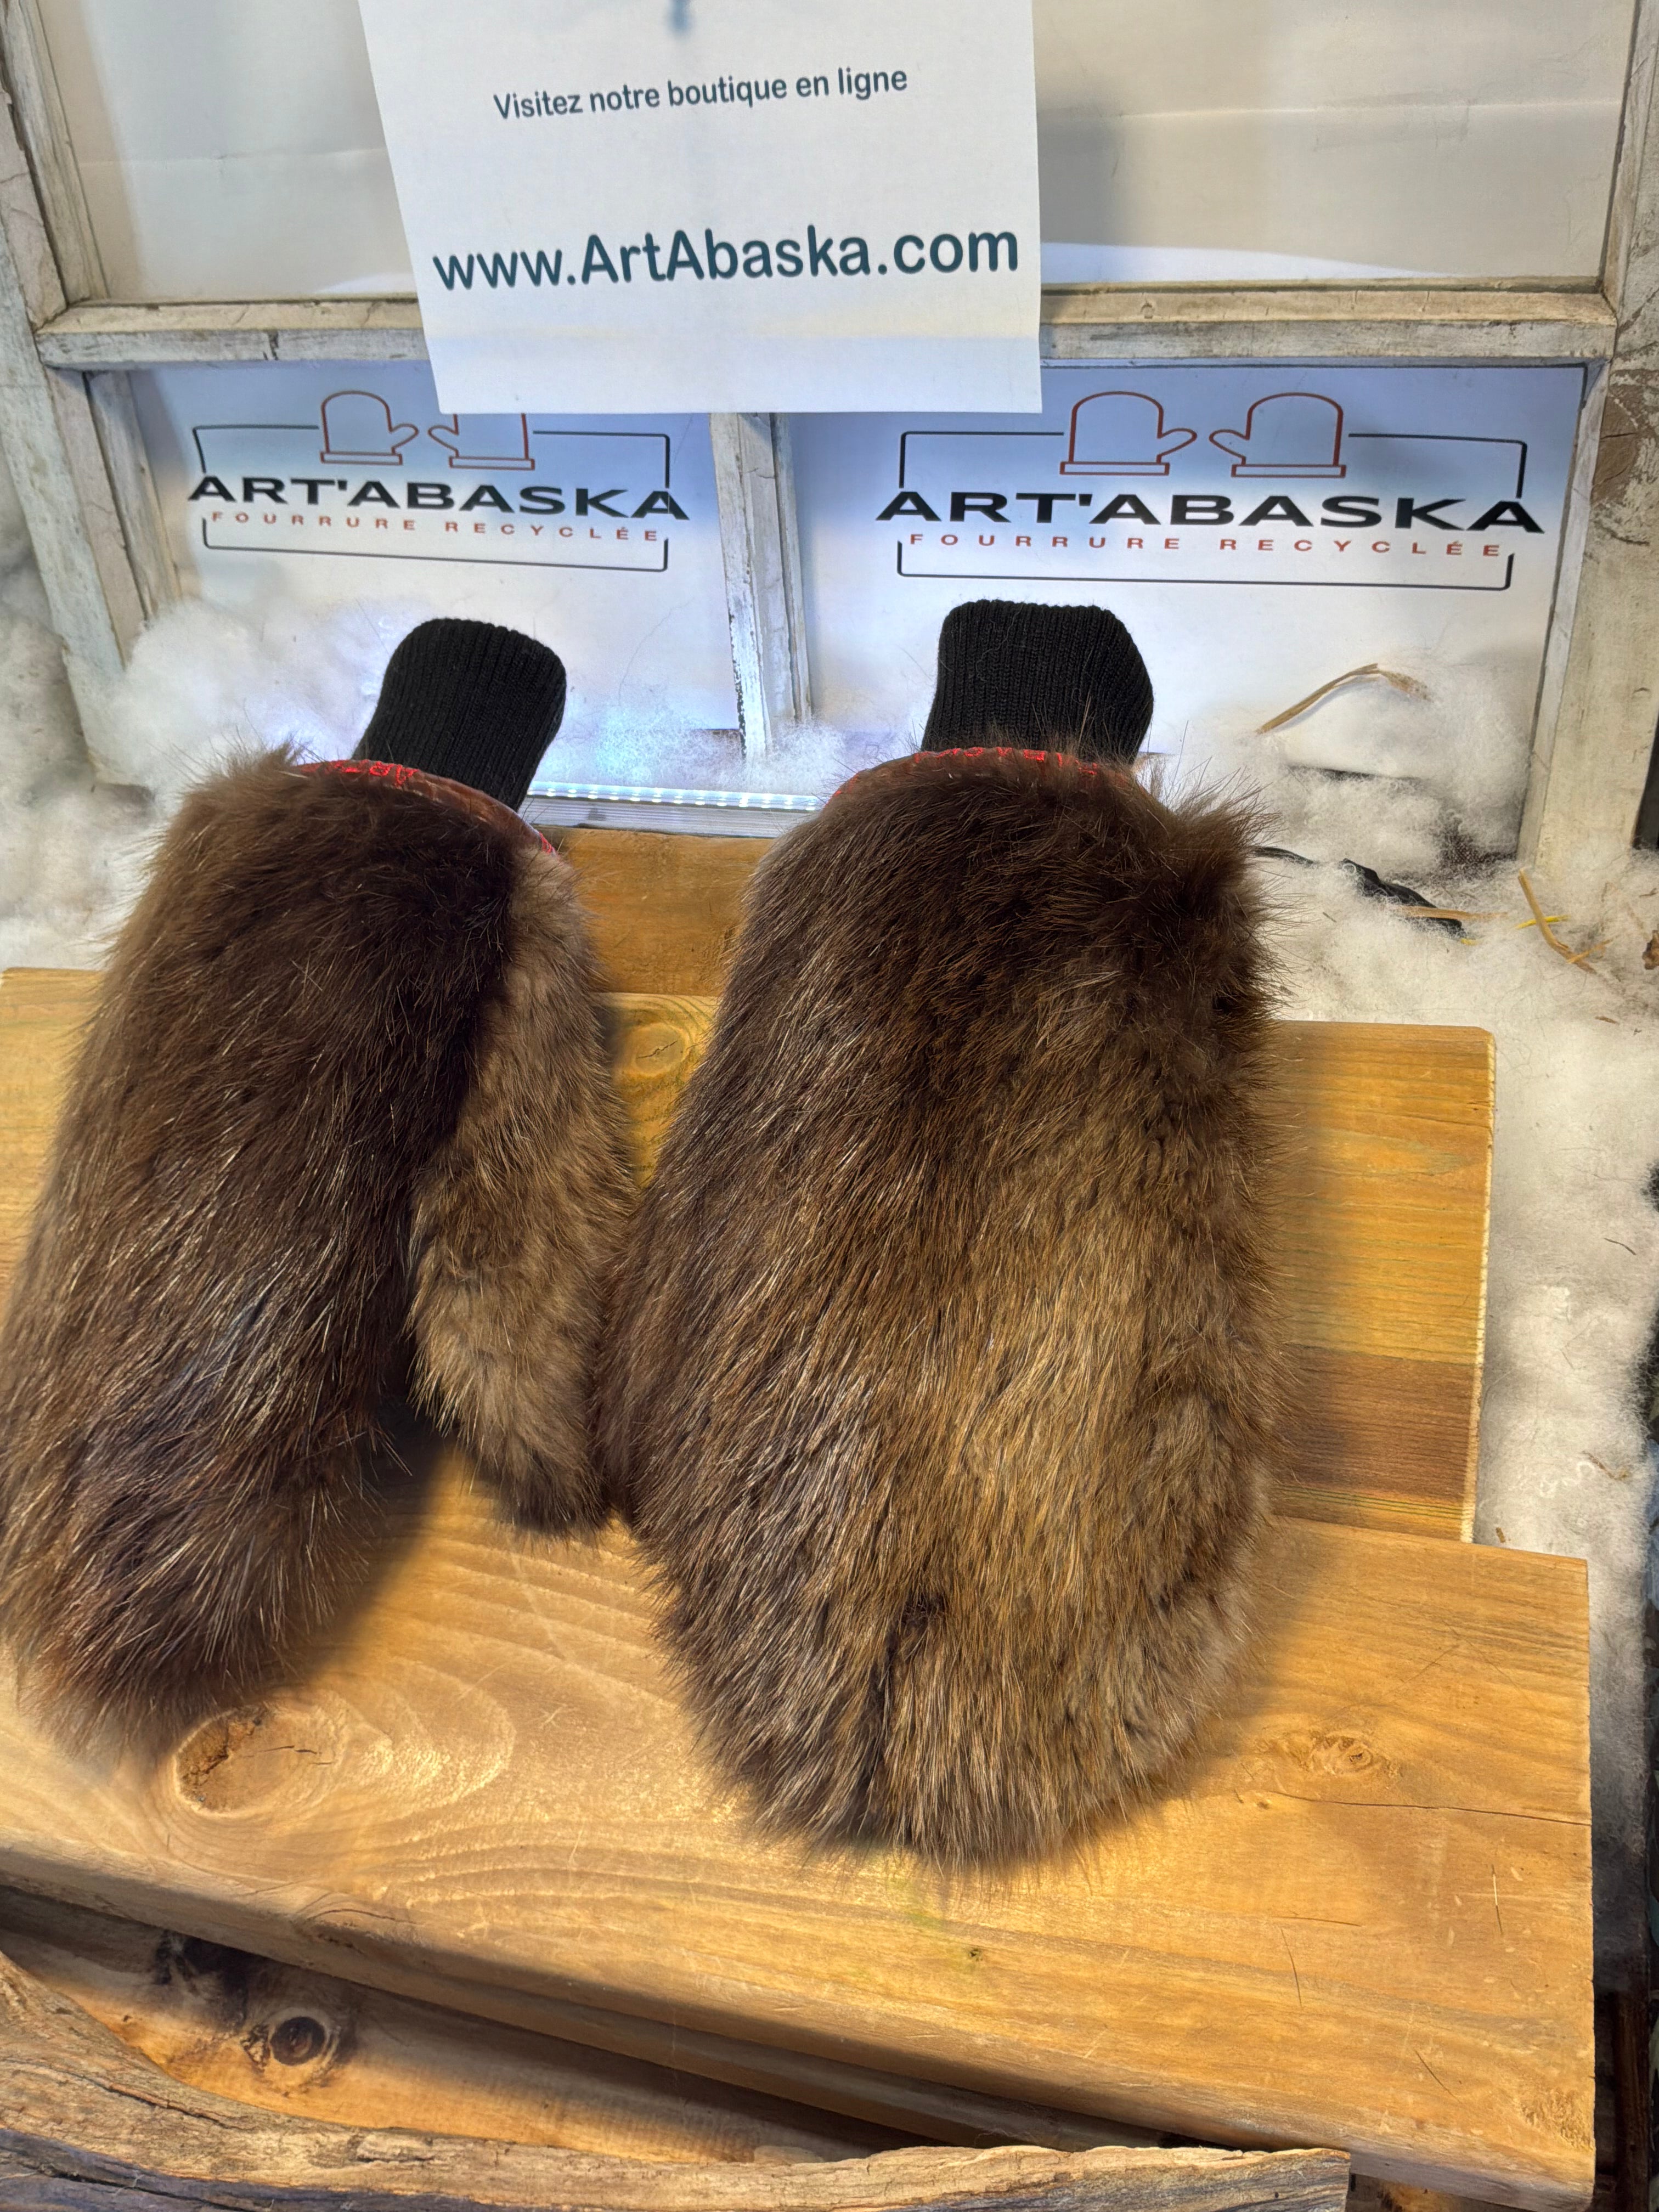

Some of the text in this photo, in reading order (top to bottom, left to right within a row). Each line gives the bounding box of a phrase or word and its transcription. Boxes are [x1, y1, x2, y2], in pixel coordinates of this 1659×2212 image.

[493, 66, 909, 119] Visitez notre boutique en ligne
[432, 224, 1018, 290] www.ArtAbaska.com
[187, 476, 690, 521] ART'ABASKA
[875, 490, 1544, 534] ART'ABASKA
[212, 511, 658, 542] FOURRURE RECYCLÉE
[910, 534, 1500, 557] FOURRURE RECYCLÉE
